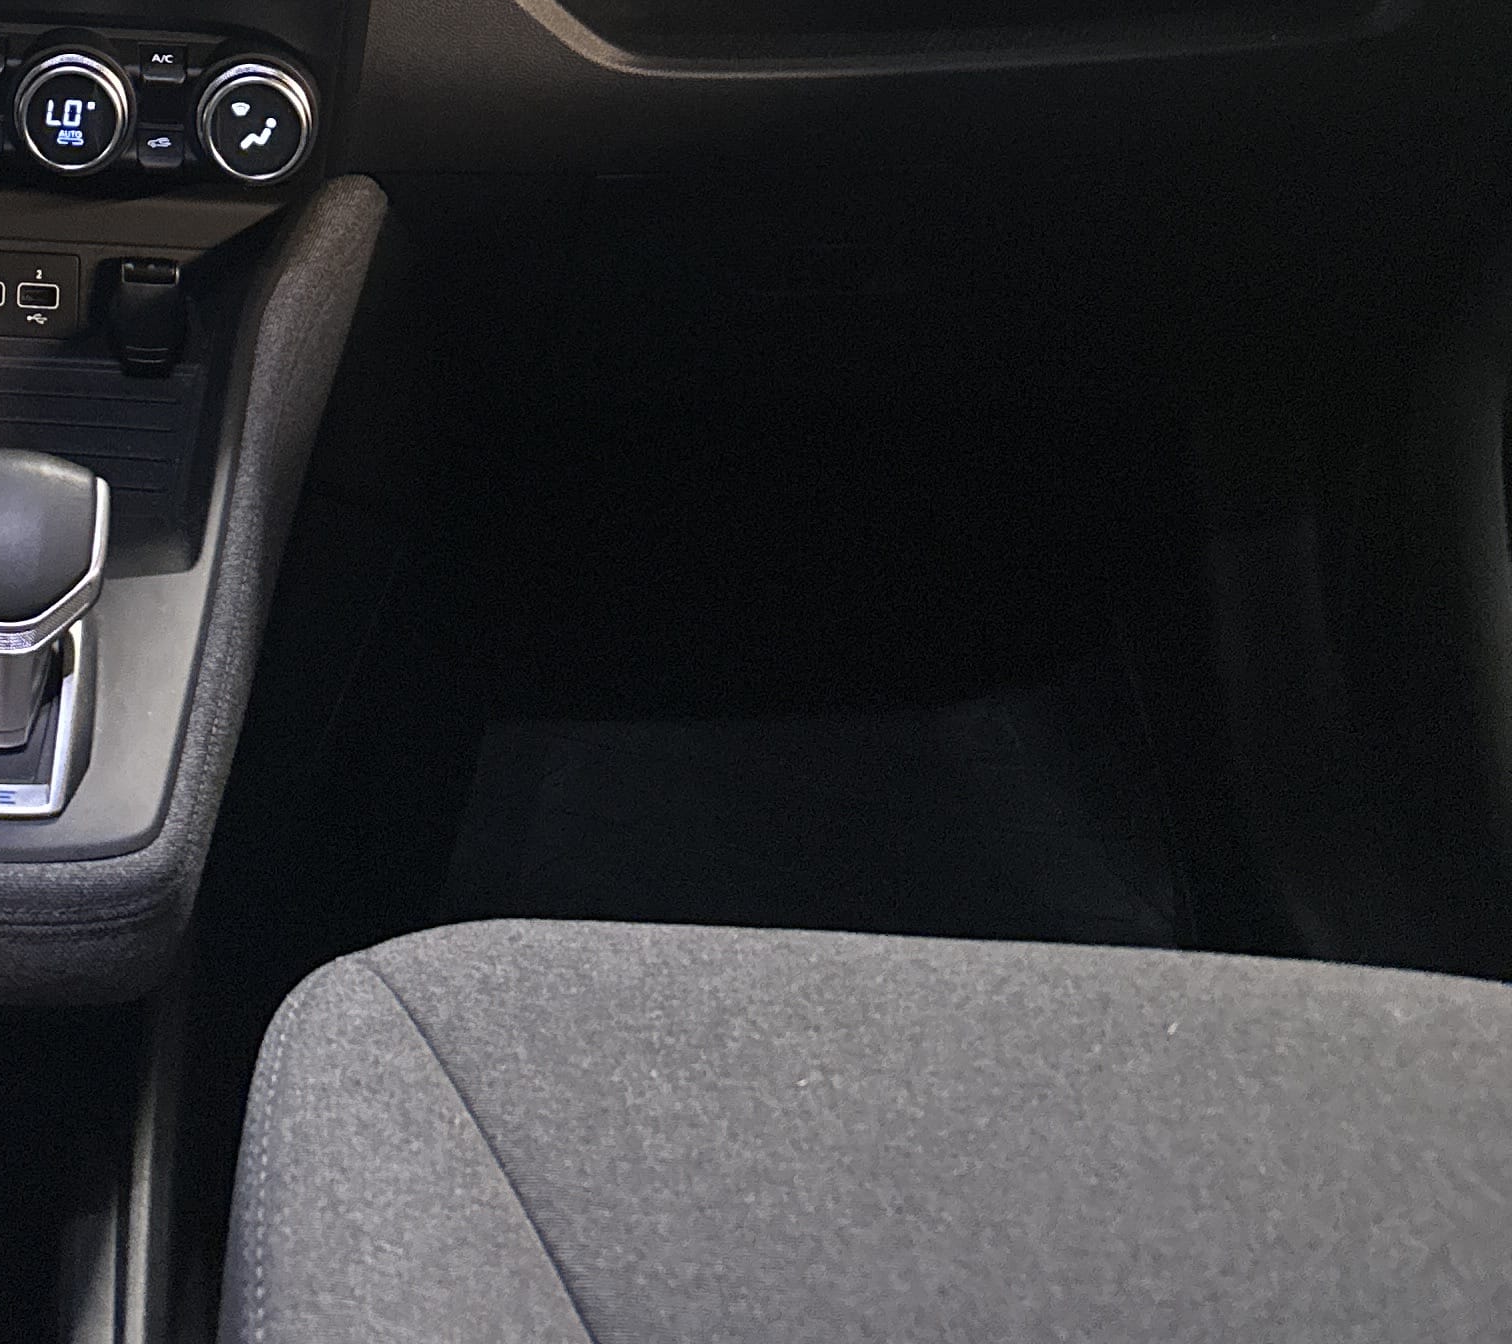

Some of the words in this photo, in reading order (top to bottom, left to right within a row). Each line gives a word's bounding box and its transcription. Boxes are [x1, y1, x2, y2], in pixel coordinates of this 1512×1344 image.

[151, 53, 175, 63] A/C
[58, 129, 83, 139] AUTO
[36, 269, 43, 280] 2
